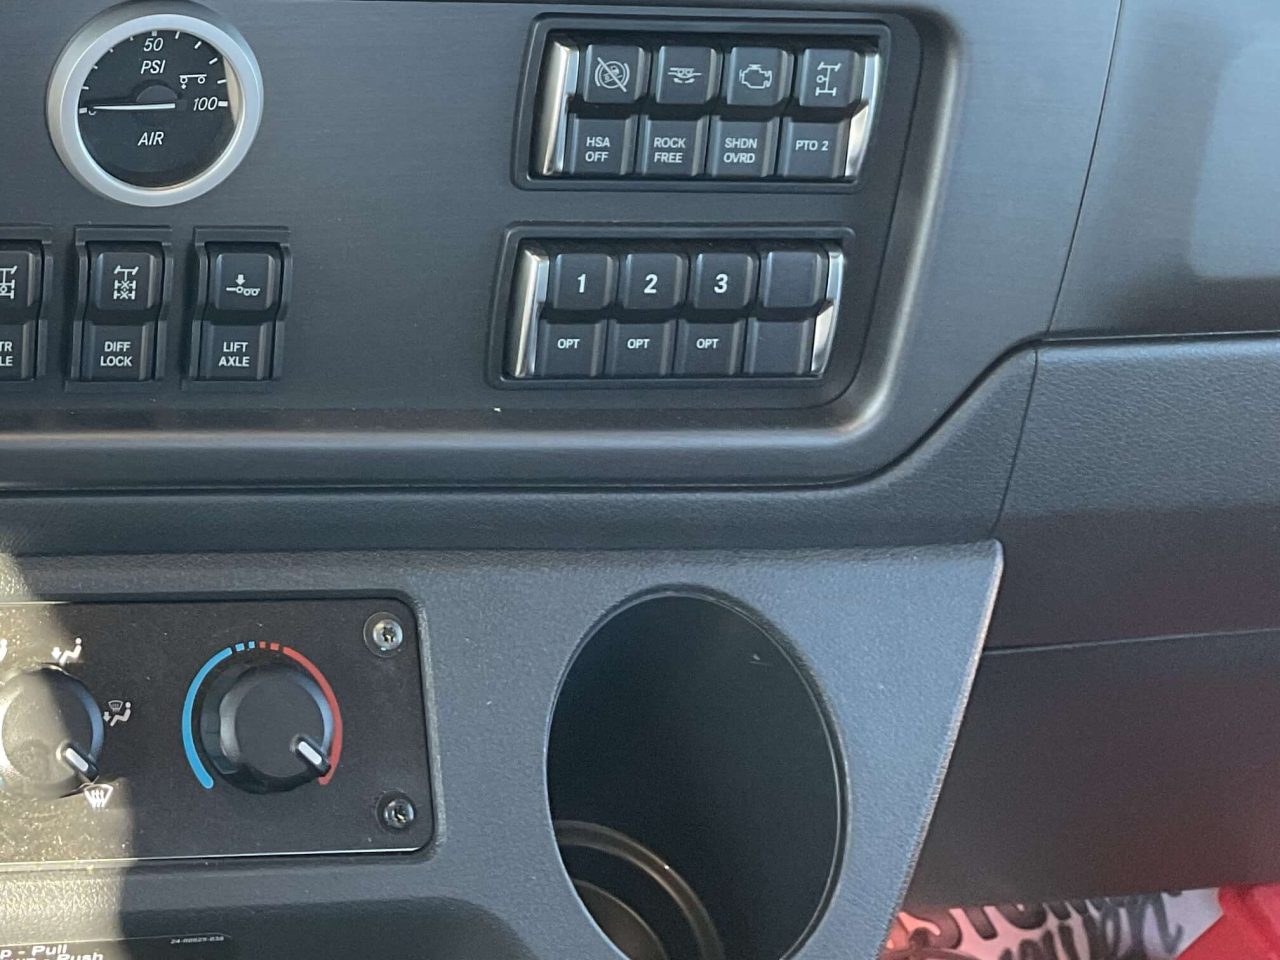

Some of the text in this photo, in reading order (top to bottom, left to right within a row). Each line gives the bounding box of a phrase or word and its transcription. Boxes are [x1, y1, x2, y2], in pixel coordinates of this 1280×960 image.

[143, 37, 164, 52] 50
[140, 59, 166, 75] PSI
[192, 96, 218, 111] 100
[137, 131, 165, 147] AIR
[586, 136, 610, 147] HSA
[653, 137, 686, 148] ROCK
[724, 137, 758, 149] SHDN
[795, 140, 829, 151] PTO 2
[585, 151, 609, 162] OFF
[654, 152, 683, 163] FREE
[723, 152, 756, 164] OVRD
[577, 274, 586, 293] 1
[643, 274, 657, 293] 2
[713, 273, 728, 293] 3
[104, 341, 132, 352] DIFF
[222, 341, 249, 352] LIFT
[557, 338, 580, 349] OPT
[627, 338, 650, 349] OPT
[696, 338, 719, 349] OPT
[100, 355, 132, 367] LOCK
[218, 355, 250, 367] AXLE
[32, 944, 68, 956] Pull
